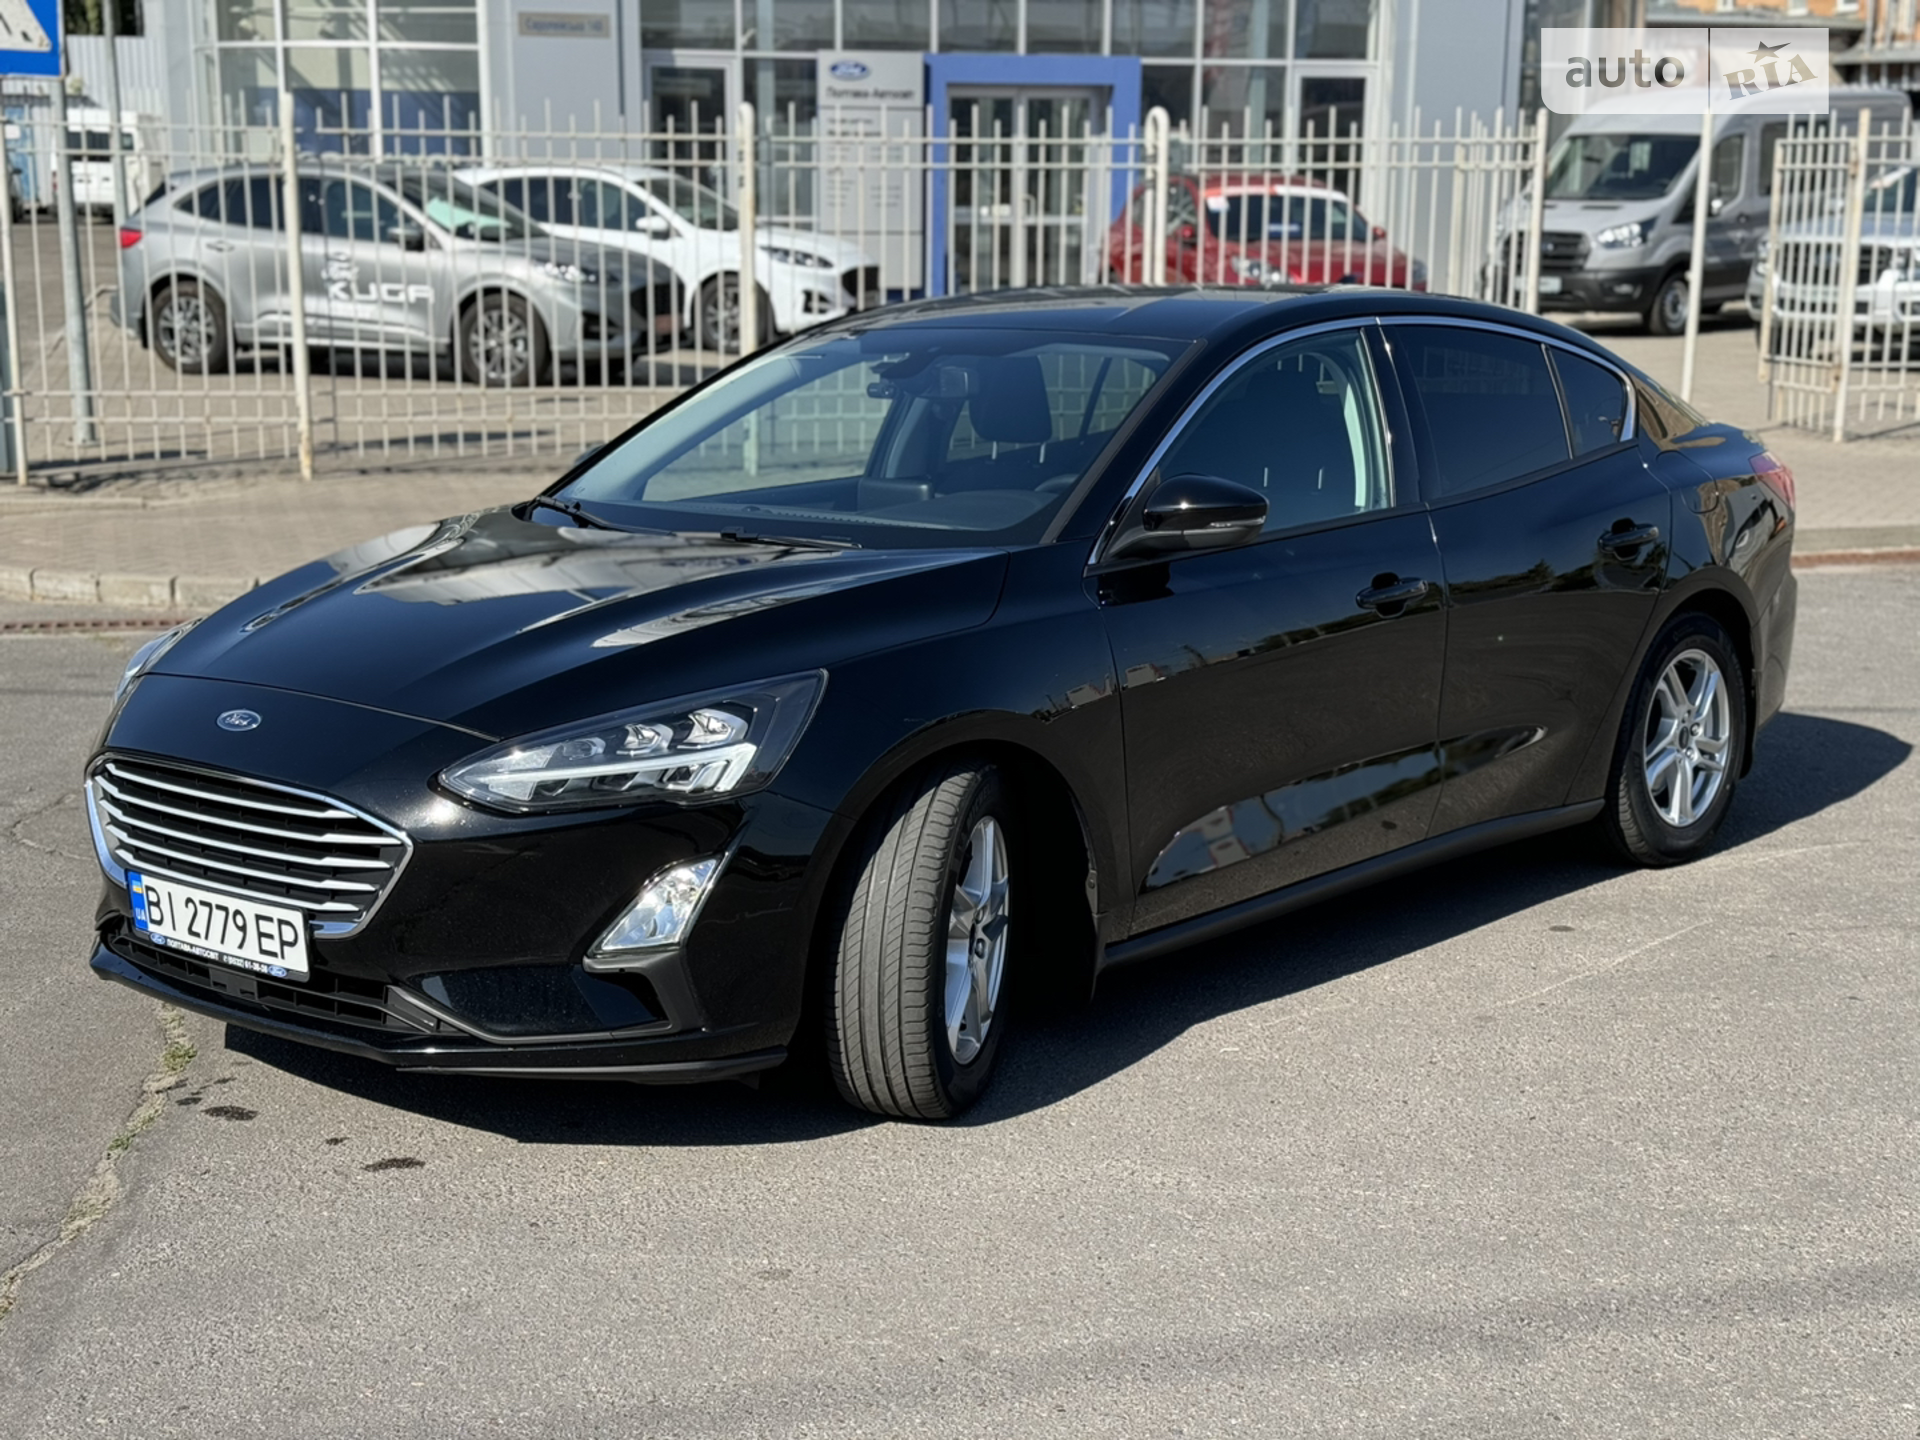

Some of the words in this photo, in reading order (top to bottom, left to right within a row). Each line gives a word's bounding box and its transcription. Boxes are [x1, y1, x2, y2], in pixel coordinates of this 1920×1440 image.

[327, 281, 435, 304] KUGA
[135, 907, 147, 921] UA
[145, 885, 176, 932] BI
[184, 896, 248, 951] 2779
[254, 913, 299, 961] EP
